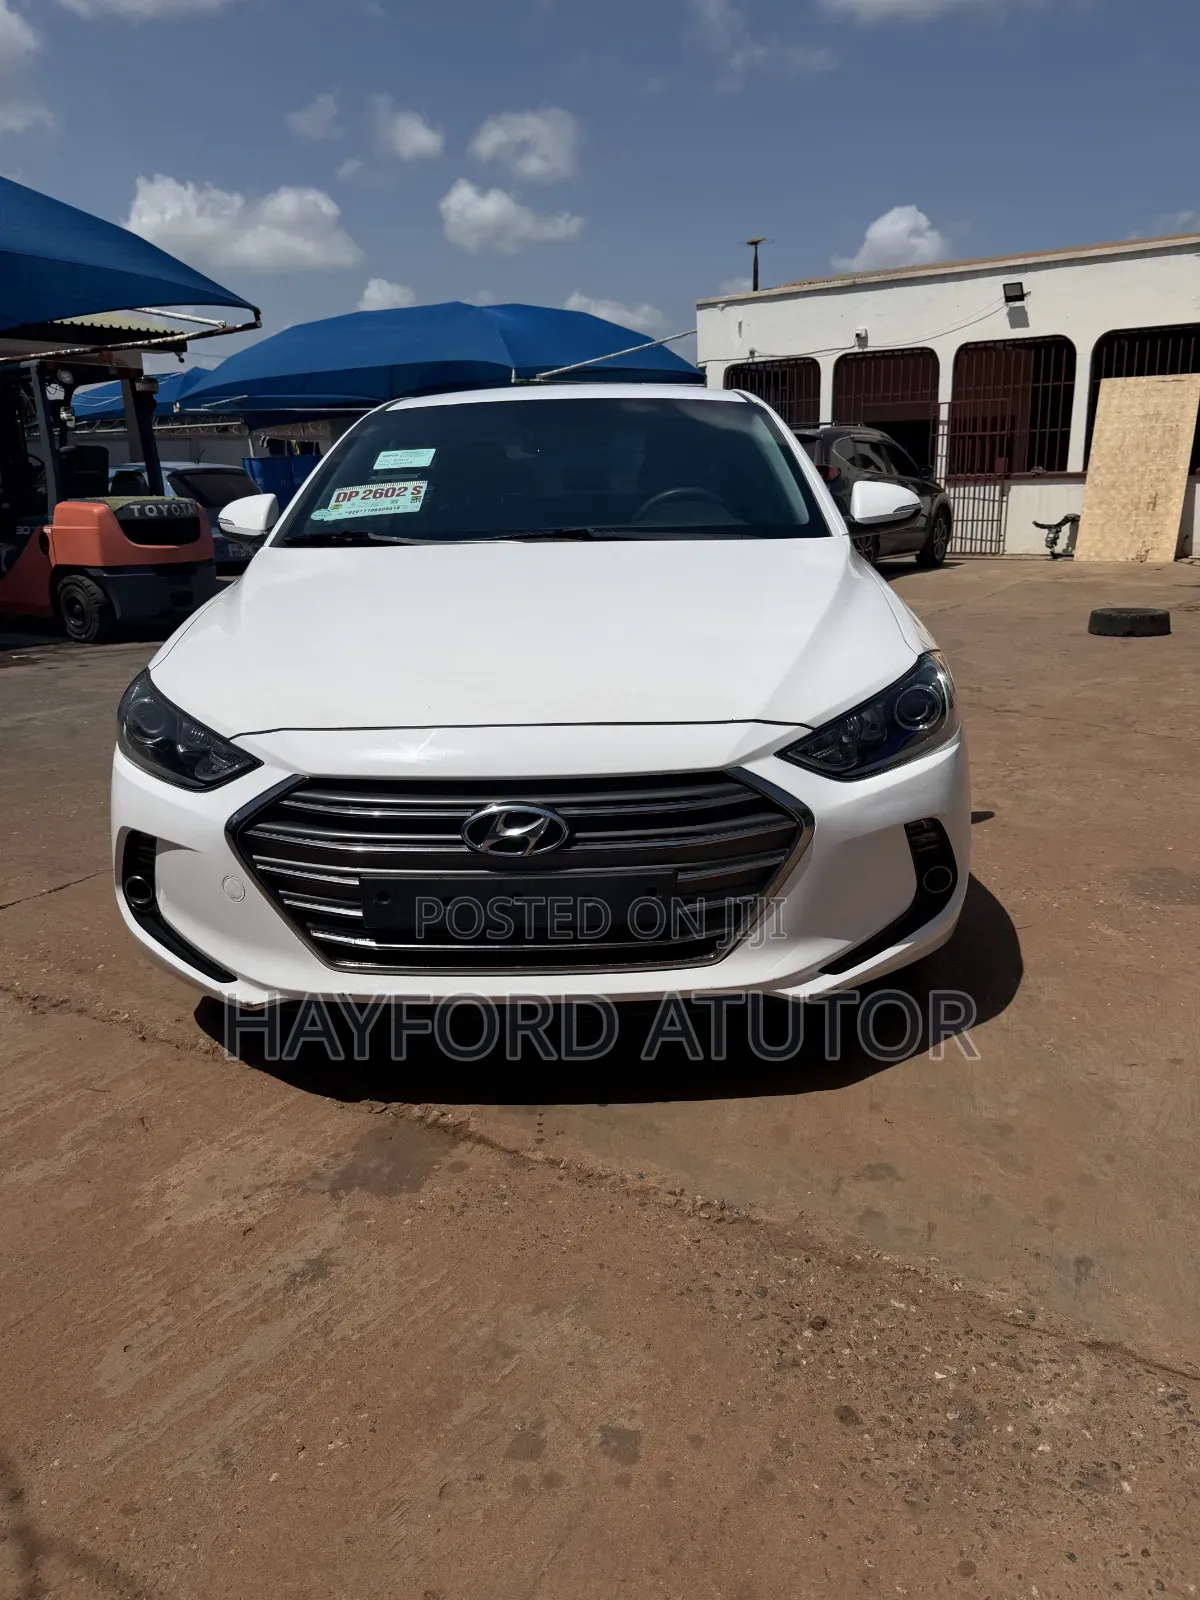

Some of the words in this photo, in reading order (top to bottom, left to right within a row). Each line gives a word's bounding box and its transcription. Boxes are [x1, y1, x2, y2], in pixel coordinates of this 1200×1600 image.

[334, 490, 360, 503] DP
[360, 486, 409, 501] 2602
[410, 485, 424, 496] S
[129, 503, 196, 517] TOYOTA
